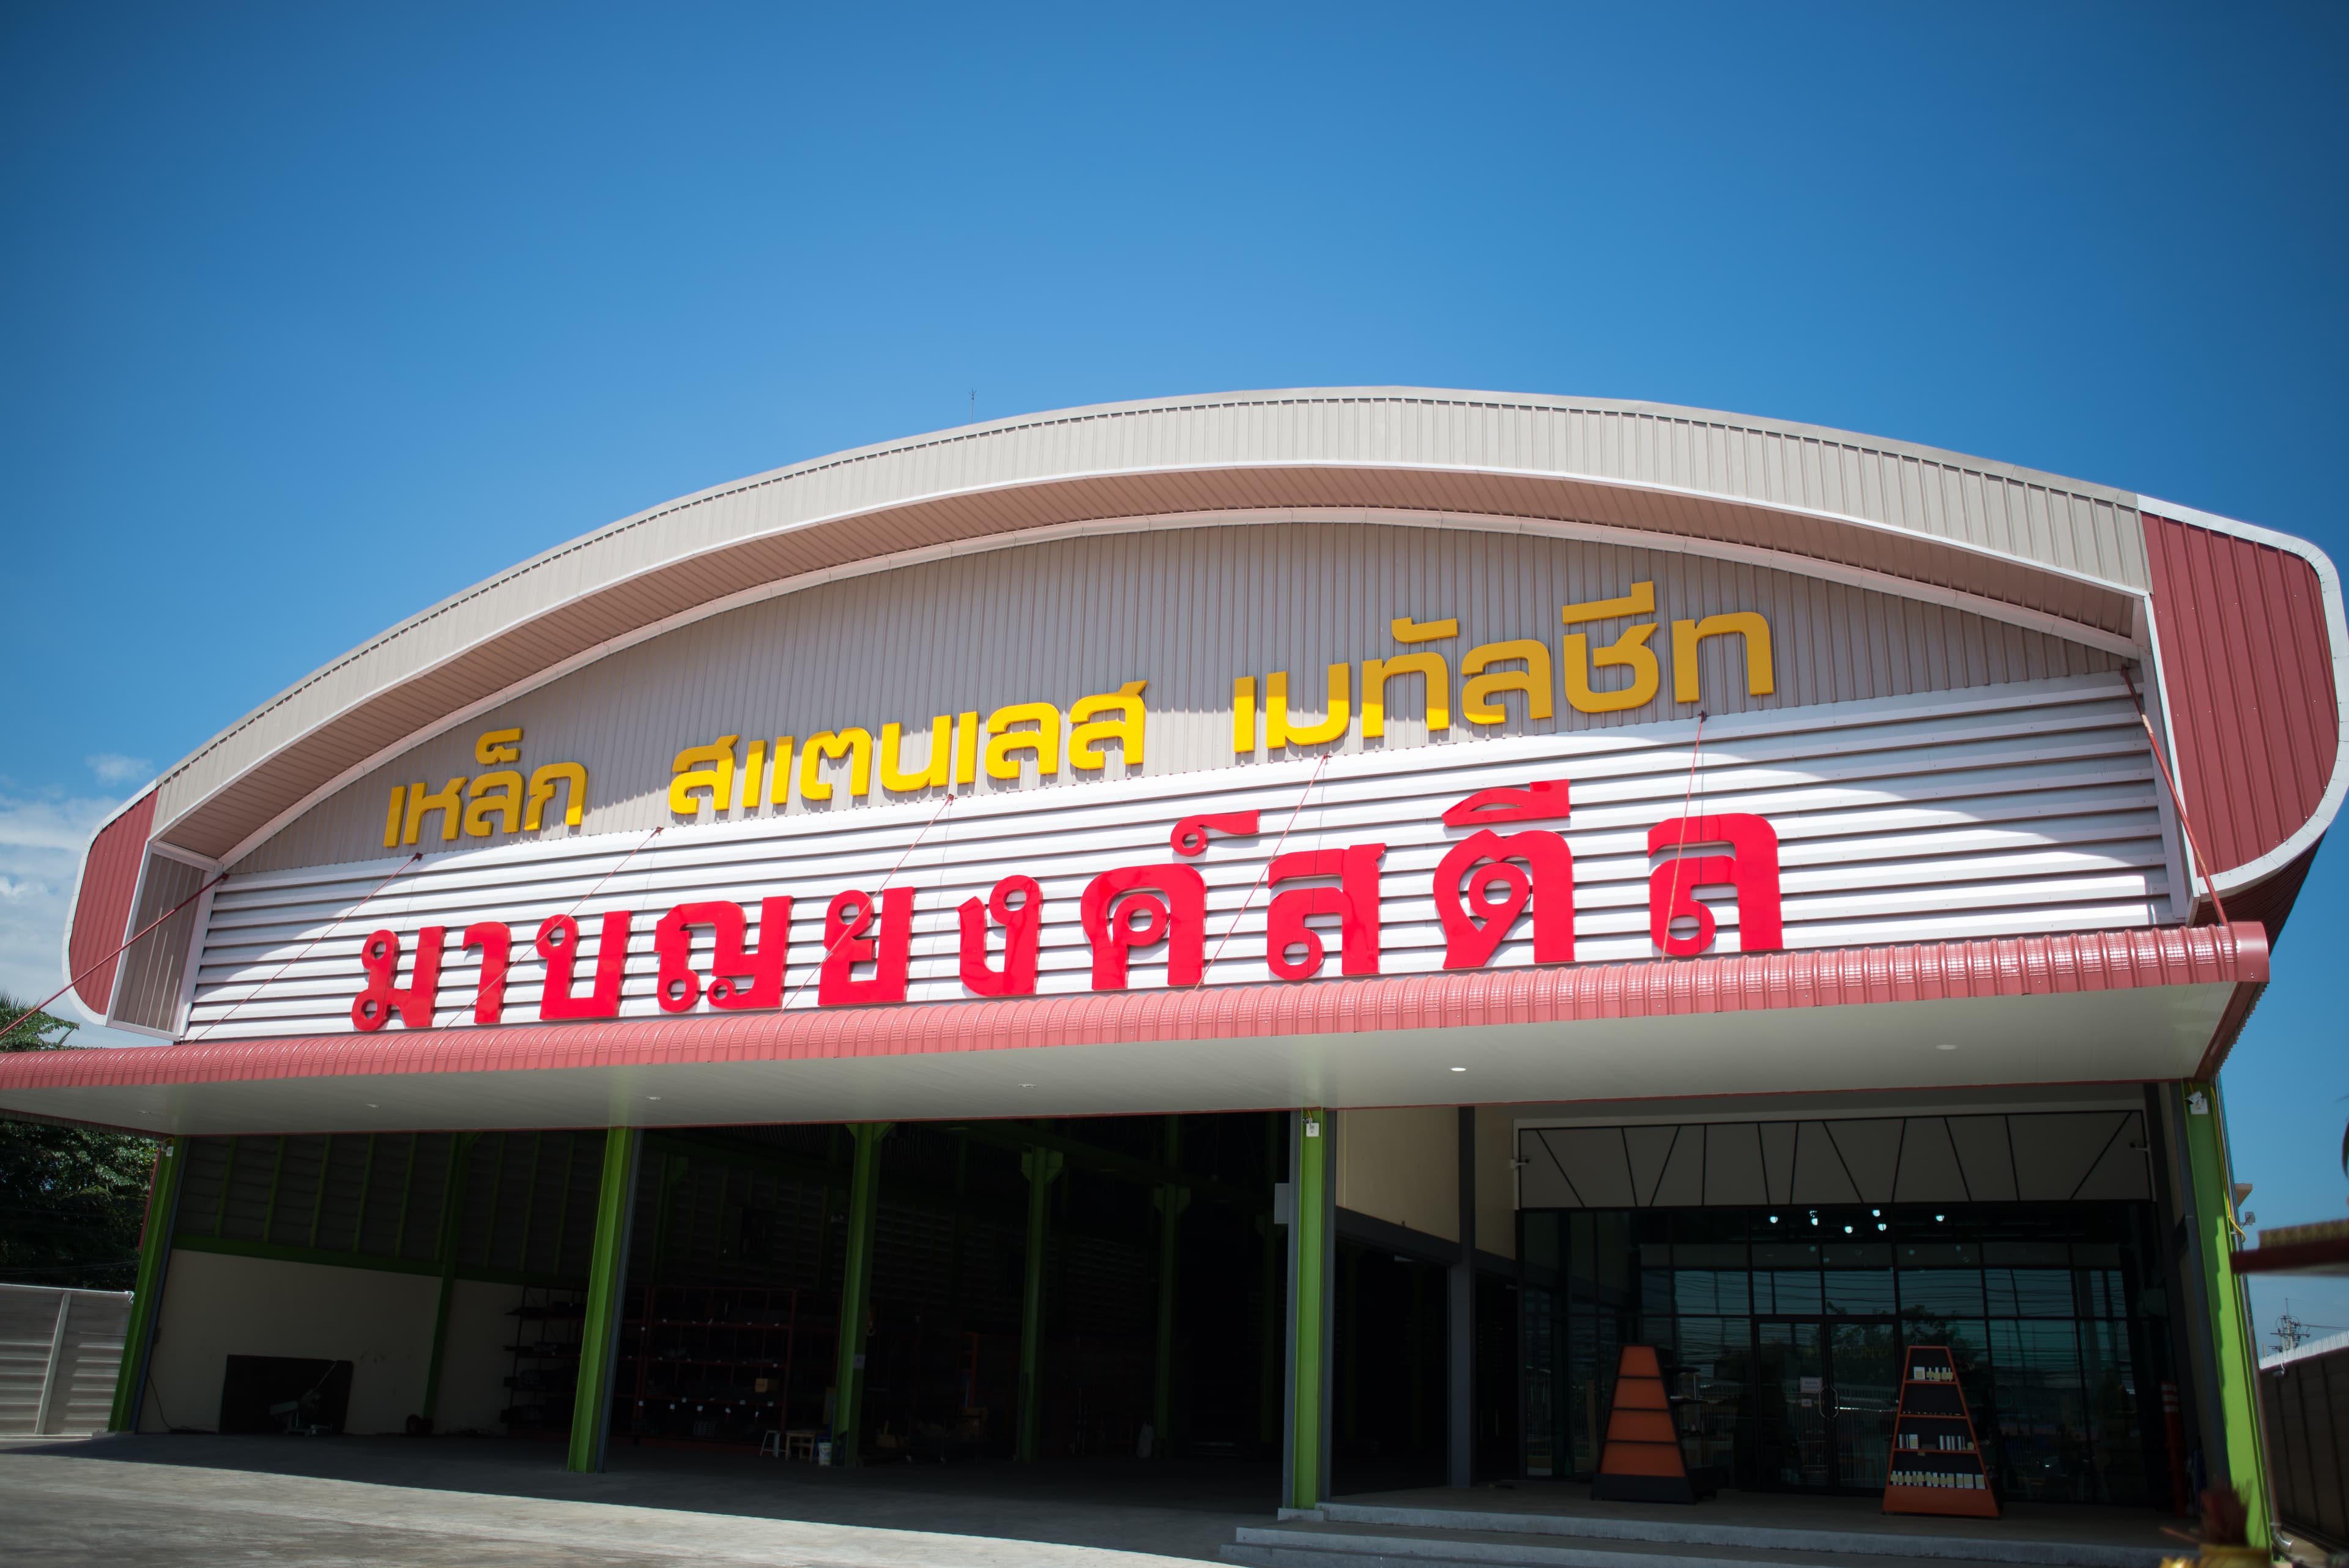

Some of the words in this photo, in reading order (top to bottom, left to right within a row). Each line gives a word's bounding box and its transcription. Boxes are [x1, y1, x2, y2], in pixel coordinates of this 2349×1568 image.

[384, 727, 588, 848] เหล็ก
[669, 680, 1148, 816] สแตนเลส
[1233, 581, 1775, 753] เมทัลชีท
[351, 779, 1784, 1032] มาบญยงค์สตีล
